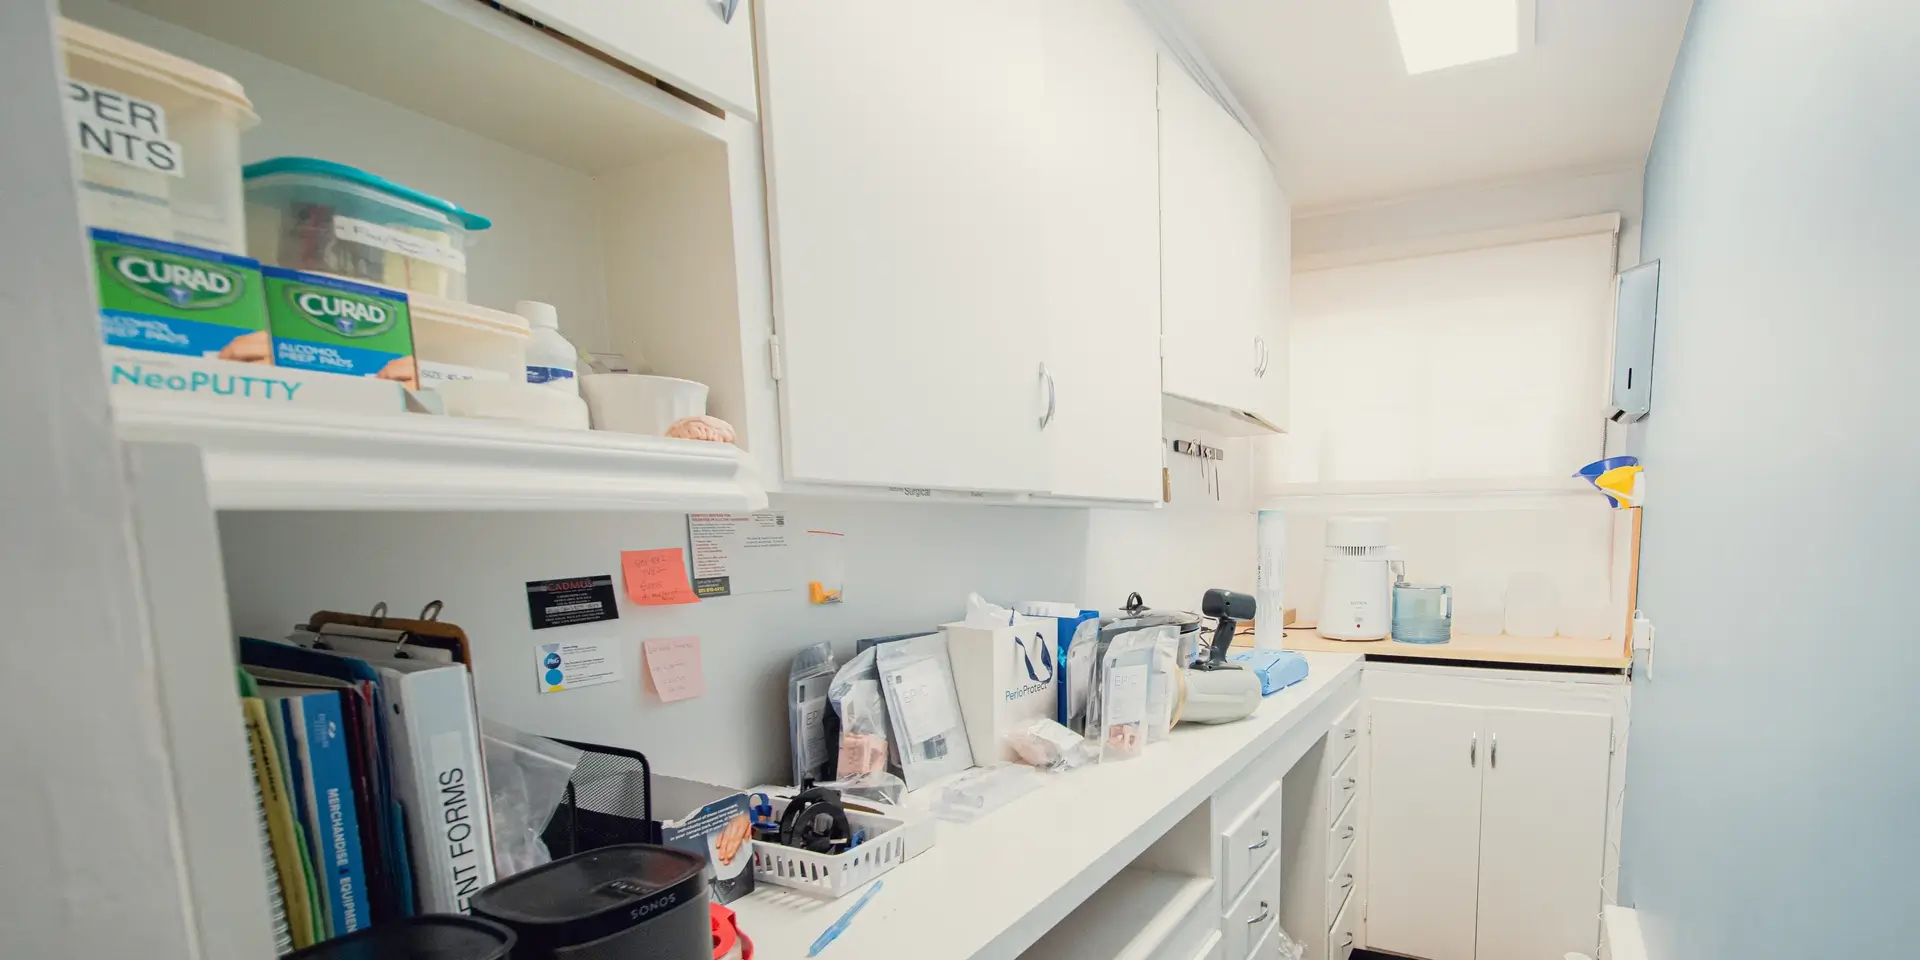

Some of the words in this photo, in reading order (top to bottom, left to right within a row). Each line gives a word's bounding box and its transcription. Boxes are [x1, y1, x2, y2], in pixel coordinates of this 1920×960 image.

[118, 255, 232, 293] CURAD
[299, 293, 386, 323] CURAD
[279, 342, 338, 356] ALCOHOL
[279, 351, 316, 363] PREP
[319, 355, 354, 369] PADS
[112, 364, 302, 401] NeoPUTTY
[903, 487, 931, 498] Surgical
[547, 579, 593, 592] CADMUS
[1005, 682, 1048, 702] PerioProtect
[326, 787, 349, 867] MERCHANDISE
[438, 767, 475, 859] FORMS
[630, 892, 677, 920] SONOS
